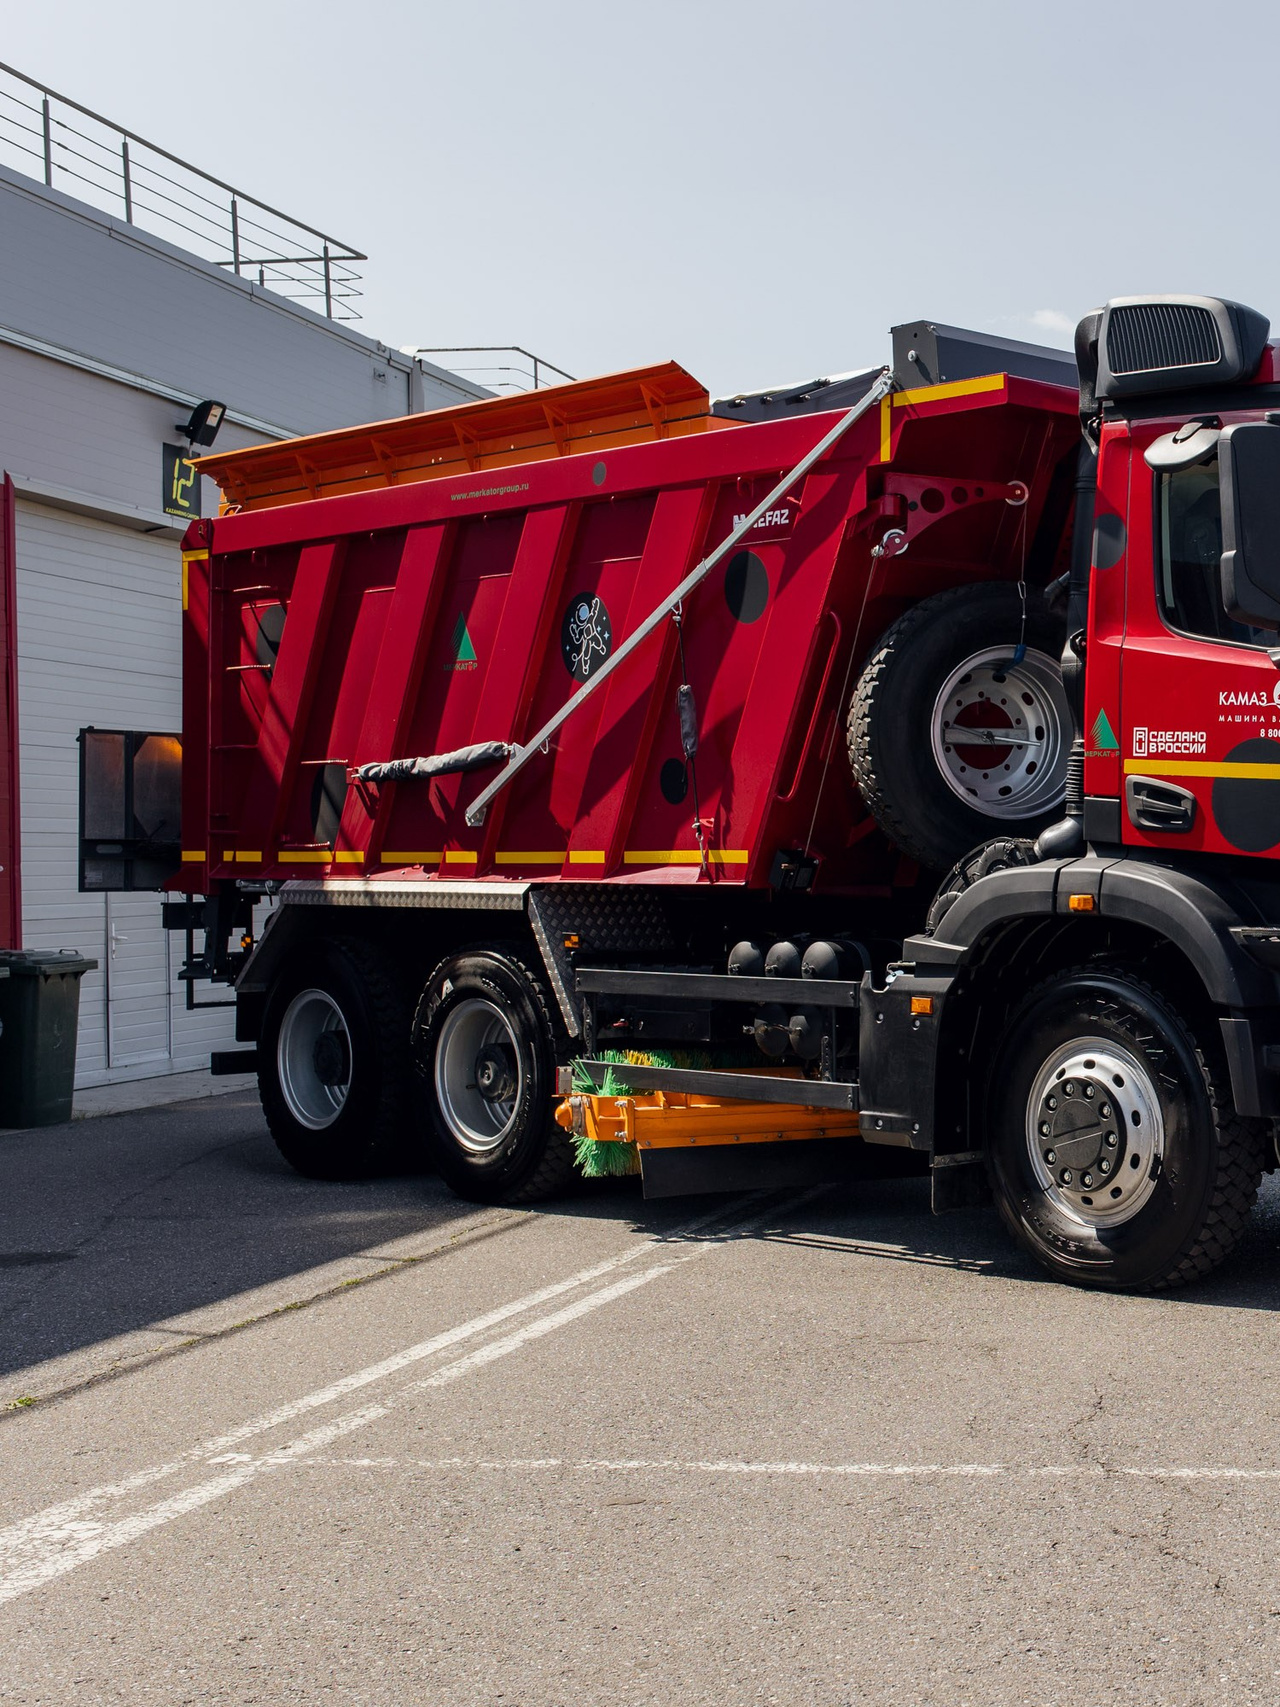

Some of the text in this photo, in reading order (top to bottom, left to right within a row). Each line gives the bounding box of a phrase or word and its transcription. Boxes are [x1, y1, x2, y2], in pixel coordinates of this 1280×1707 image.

[172, 457, 195, 508] 12
[450, 483, 530, 501] www.merkatorgroup.ru
[752, 509, 789, 528] EFAZ
[1219, 691, 1268, 706] КАМАЗ
[1219, 715, 1265, 723] МАШИНА
[1149, 731, 1207, 742] СДЕЛАНО
[1260, 728, 1265, 738] 8
